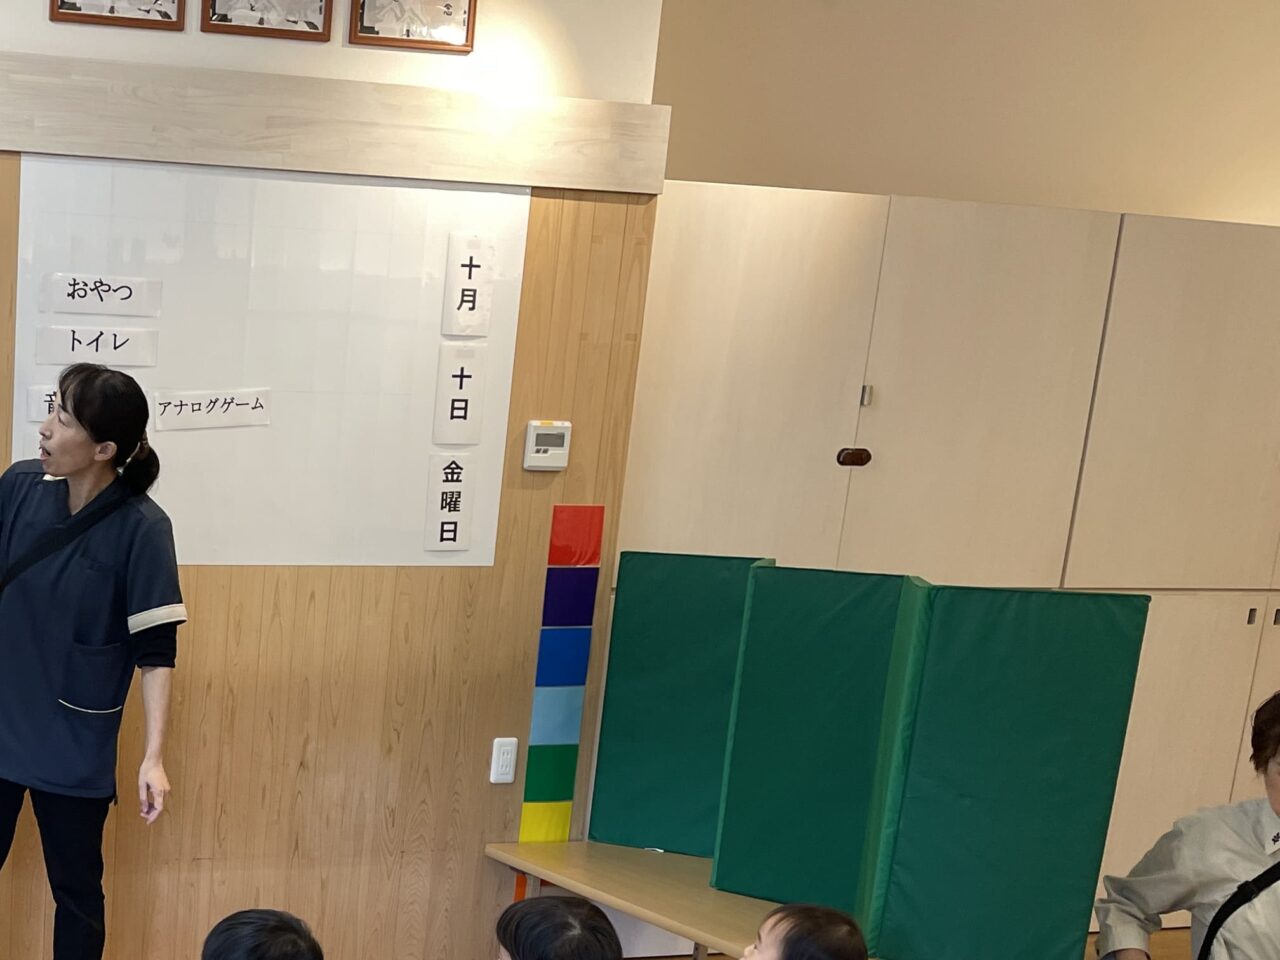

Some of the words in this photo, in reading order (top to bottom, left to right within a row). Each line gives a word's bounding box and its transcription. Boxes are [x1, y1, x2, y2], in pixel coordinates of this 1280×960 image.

[66, 278, 133, 302] おやつ
[456, 255, 481, 312] 十月
[69, 329, 130, 352] トイレ
[158, 396, 265, 416] アナログゲーム
[449, 366, 473, 421] 十日
[439, 460, 465, 543] 金曜日
